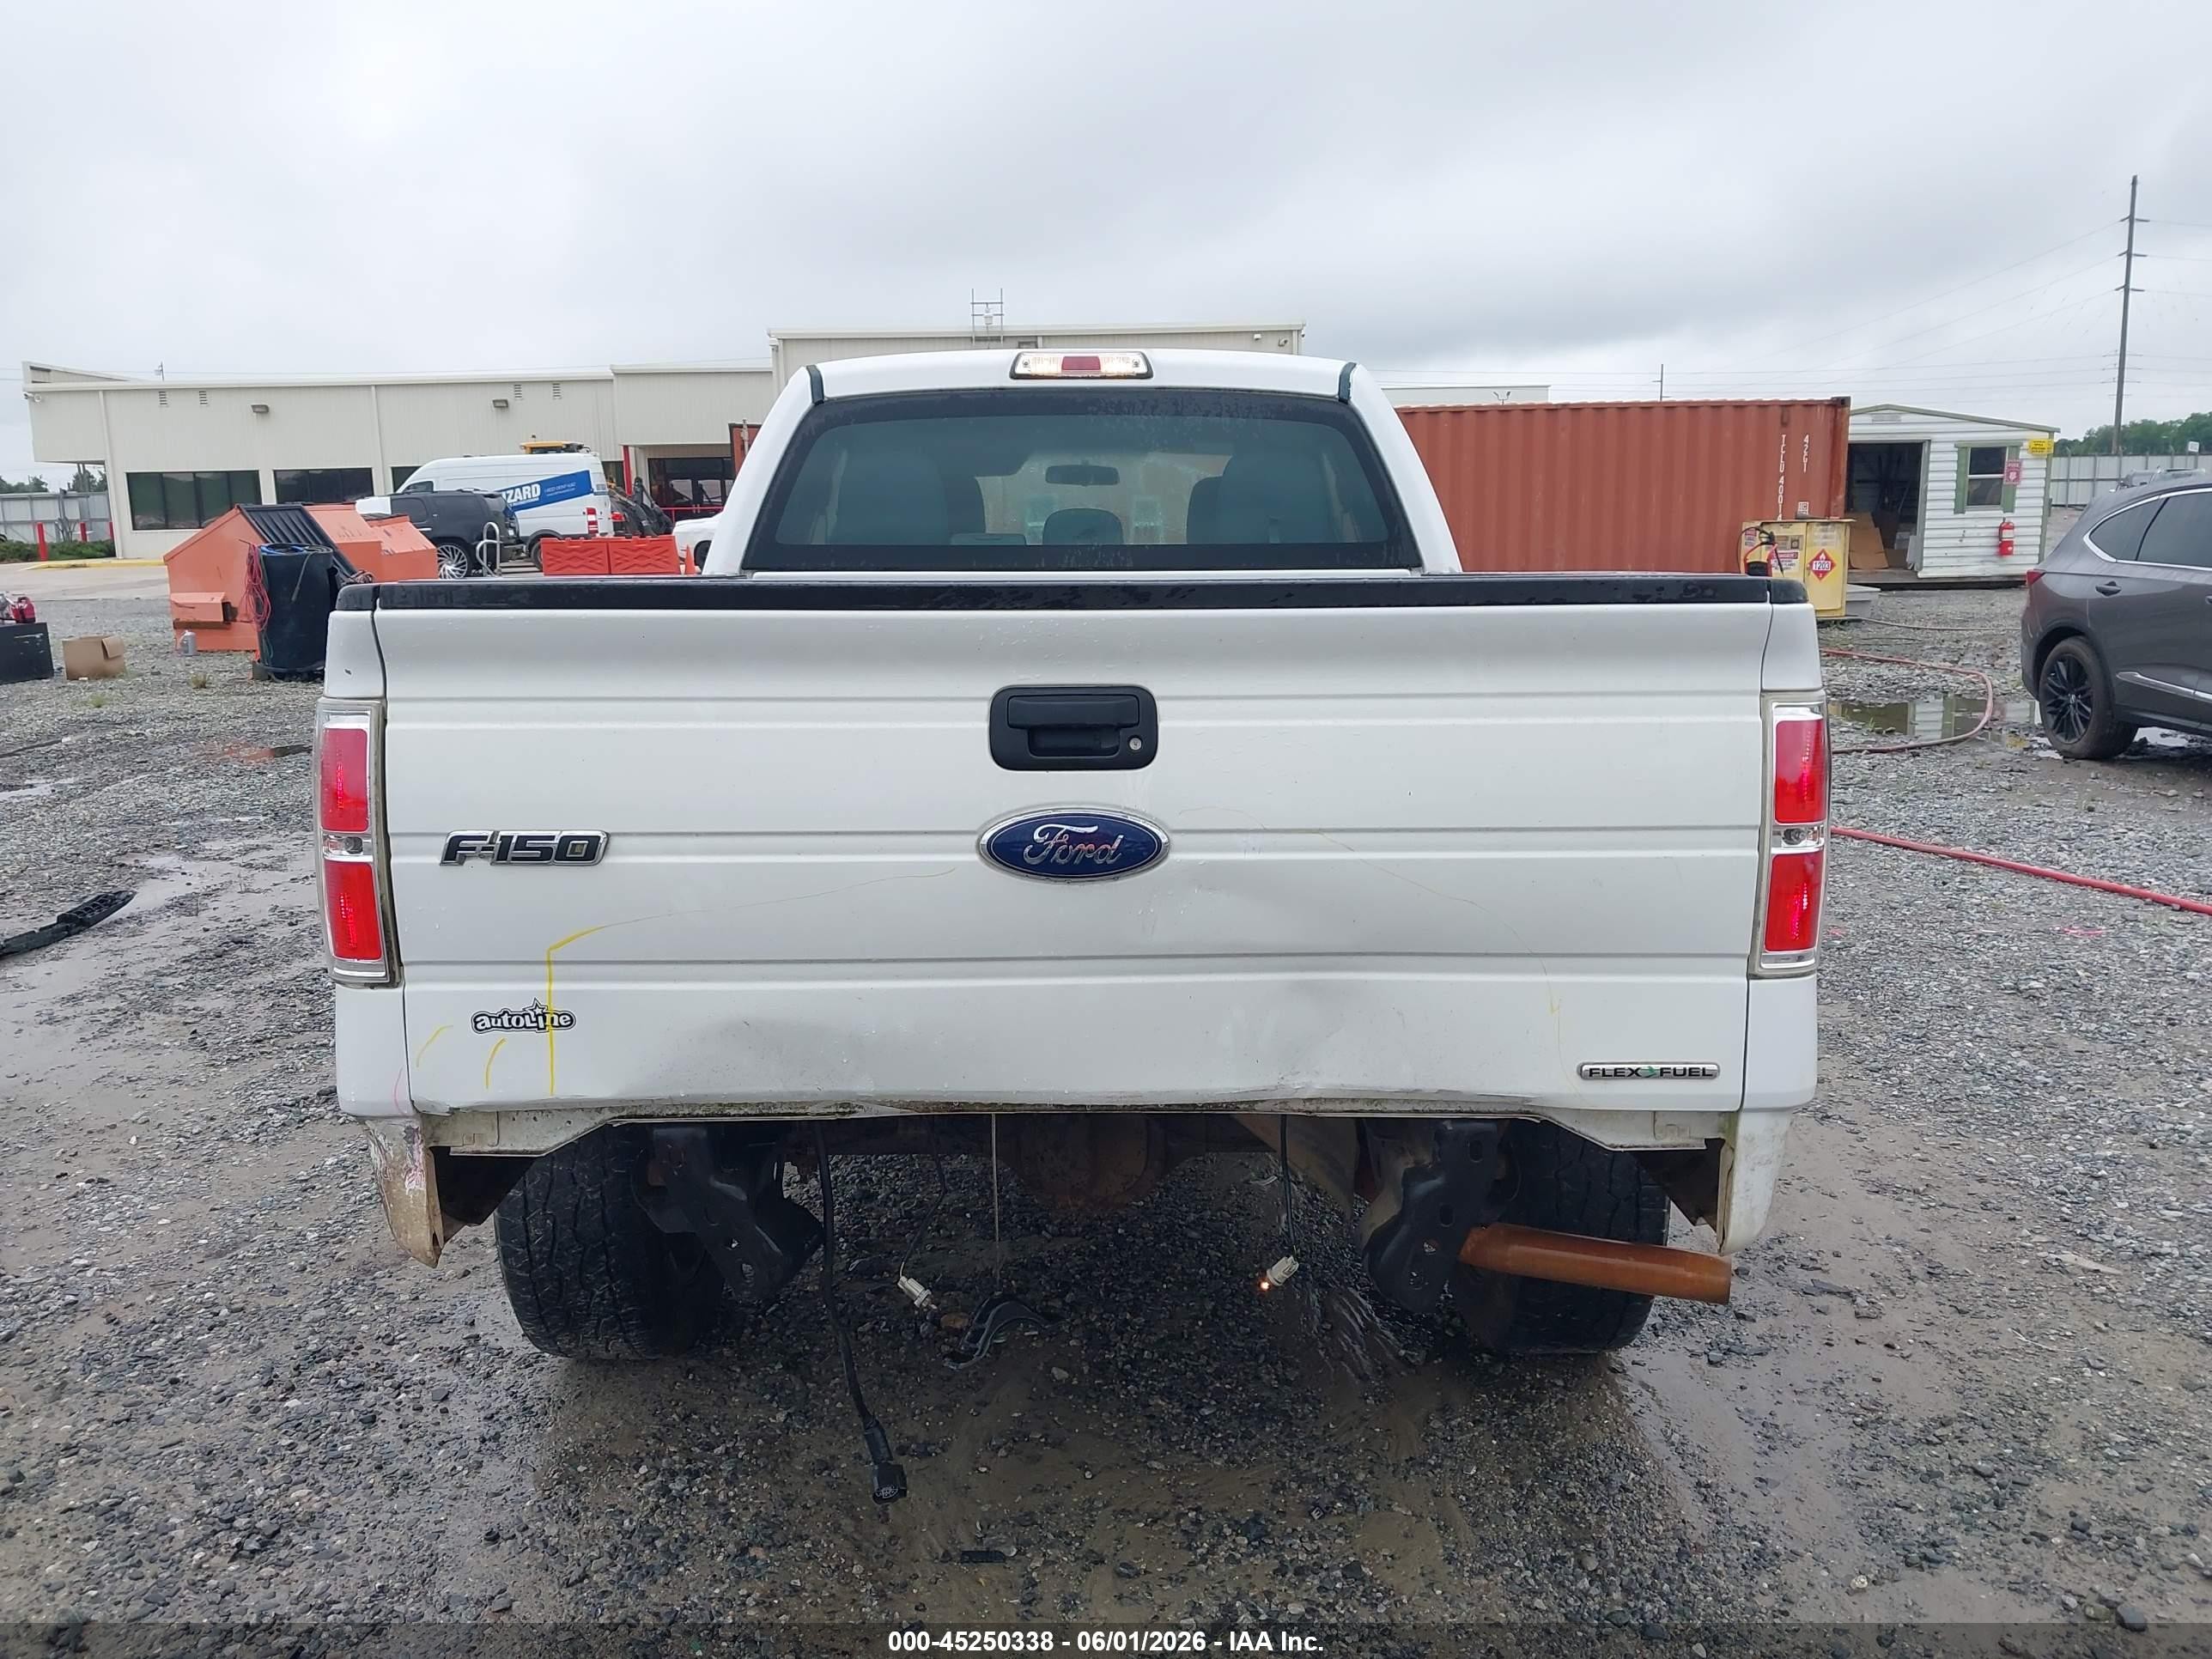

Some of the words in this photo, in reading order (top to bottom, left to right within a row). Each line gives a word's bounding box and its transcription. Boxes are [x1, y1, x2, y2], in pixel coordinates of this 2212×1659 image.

[1814, 562, 1830, 570] 1203
[441, 830, 608, 866] F-150
[1024, 823, 1124, 865] Ford
[1589, 1067, 1642, 1078] FLEX
[1659, 1066, 1713, 1077] FUEL
